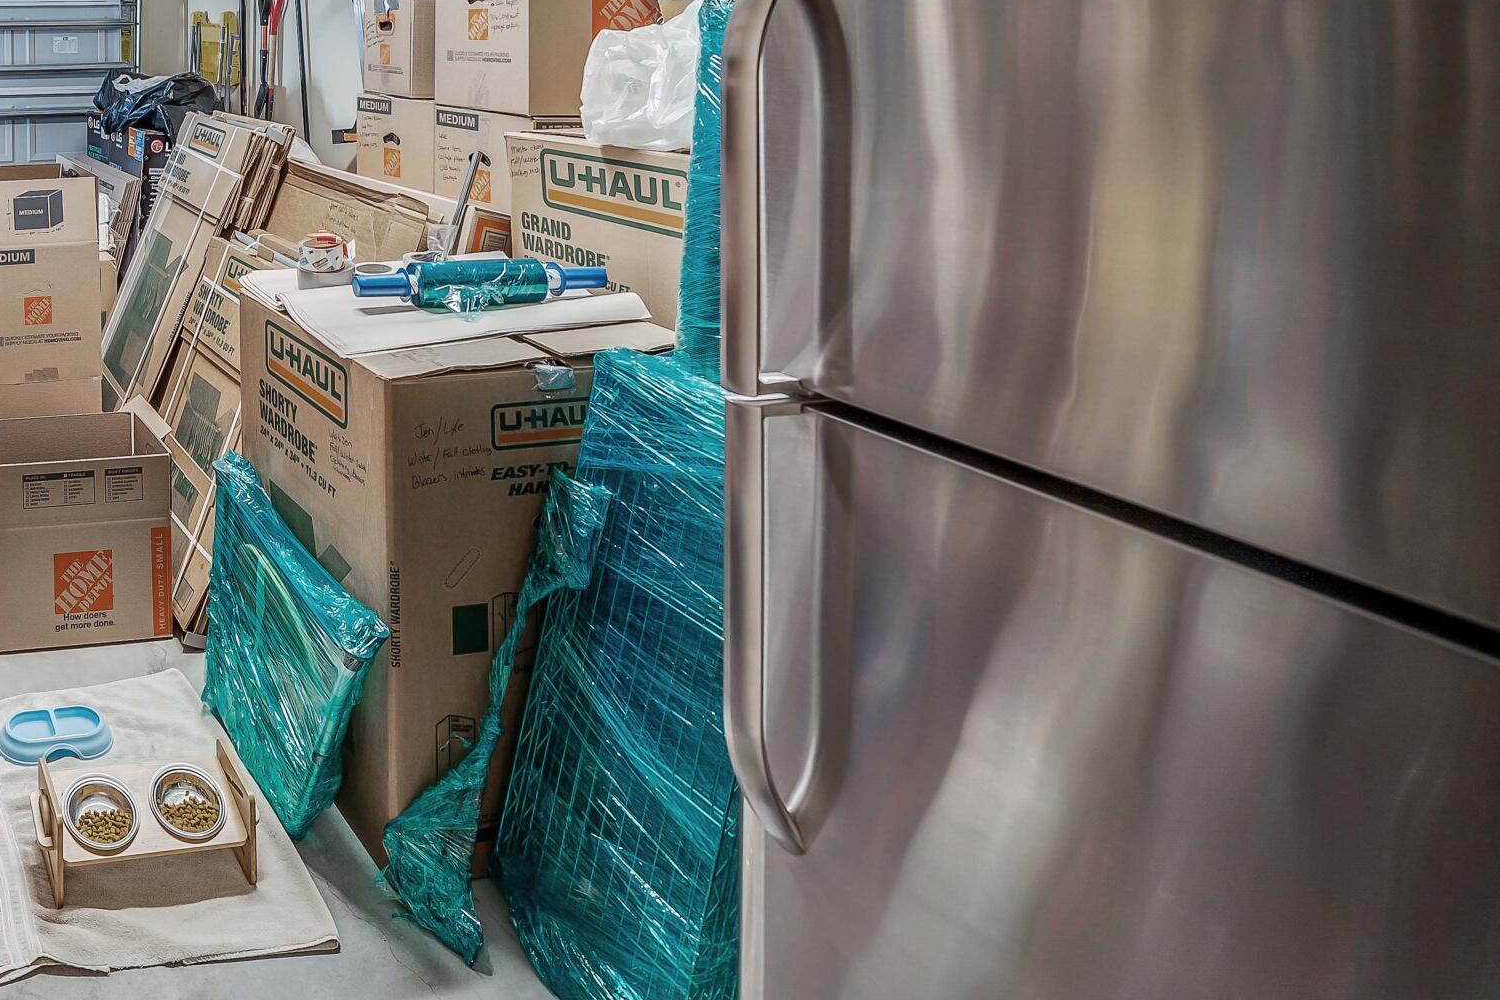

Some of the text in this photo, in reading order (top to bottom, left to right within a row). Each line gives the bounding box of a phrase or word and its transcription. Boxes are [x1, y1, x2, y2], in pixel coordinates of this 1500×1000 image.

[359, 100, 389, 112] MEDIUM
[439, 112, 476, 128] MEDIUM
[93, 118, 101, 130] LG
[115, 132, 123, 143] LG
[194, 127, 221, 148] U-HAUL
[549, 158, 682, 211] U-HAUL
[521, 211, 572, 241] GRAND
[521, 231, 608, 267] WARDROBE
[43, 336, 82, 344] HDMOVING.COM
[269, 330, 342, 402] U-HAUL
[259, 378, 298, 424] SHORTY
[259, 400, 316, 465] WARDROBE
[499, 404, 587, 432] U-HAU
[260, 424, 270, 437] 24"
[274, 437, 285, 451] 24"
[305, 464, 317, 482] 11.3
[318, 474, 327, 490] CU
[328, 483, 336, 498] FT
[508, 481, 549, 497] HAN
[54, 550, 113, 613] THE HOME DEPOT
[155, 533, 167, 632] HEAVY DUTY SMALL
[54, 620, 117, 632] get more done.
[63, 611, 107, 621] How doers
[389, 566, 401, 669] SHORTY WARDROBE
